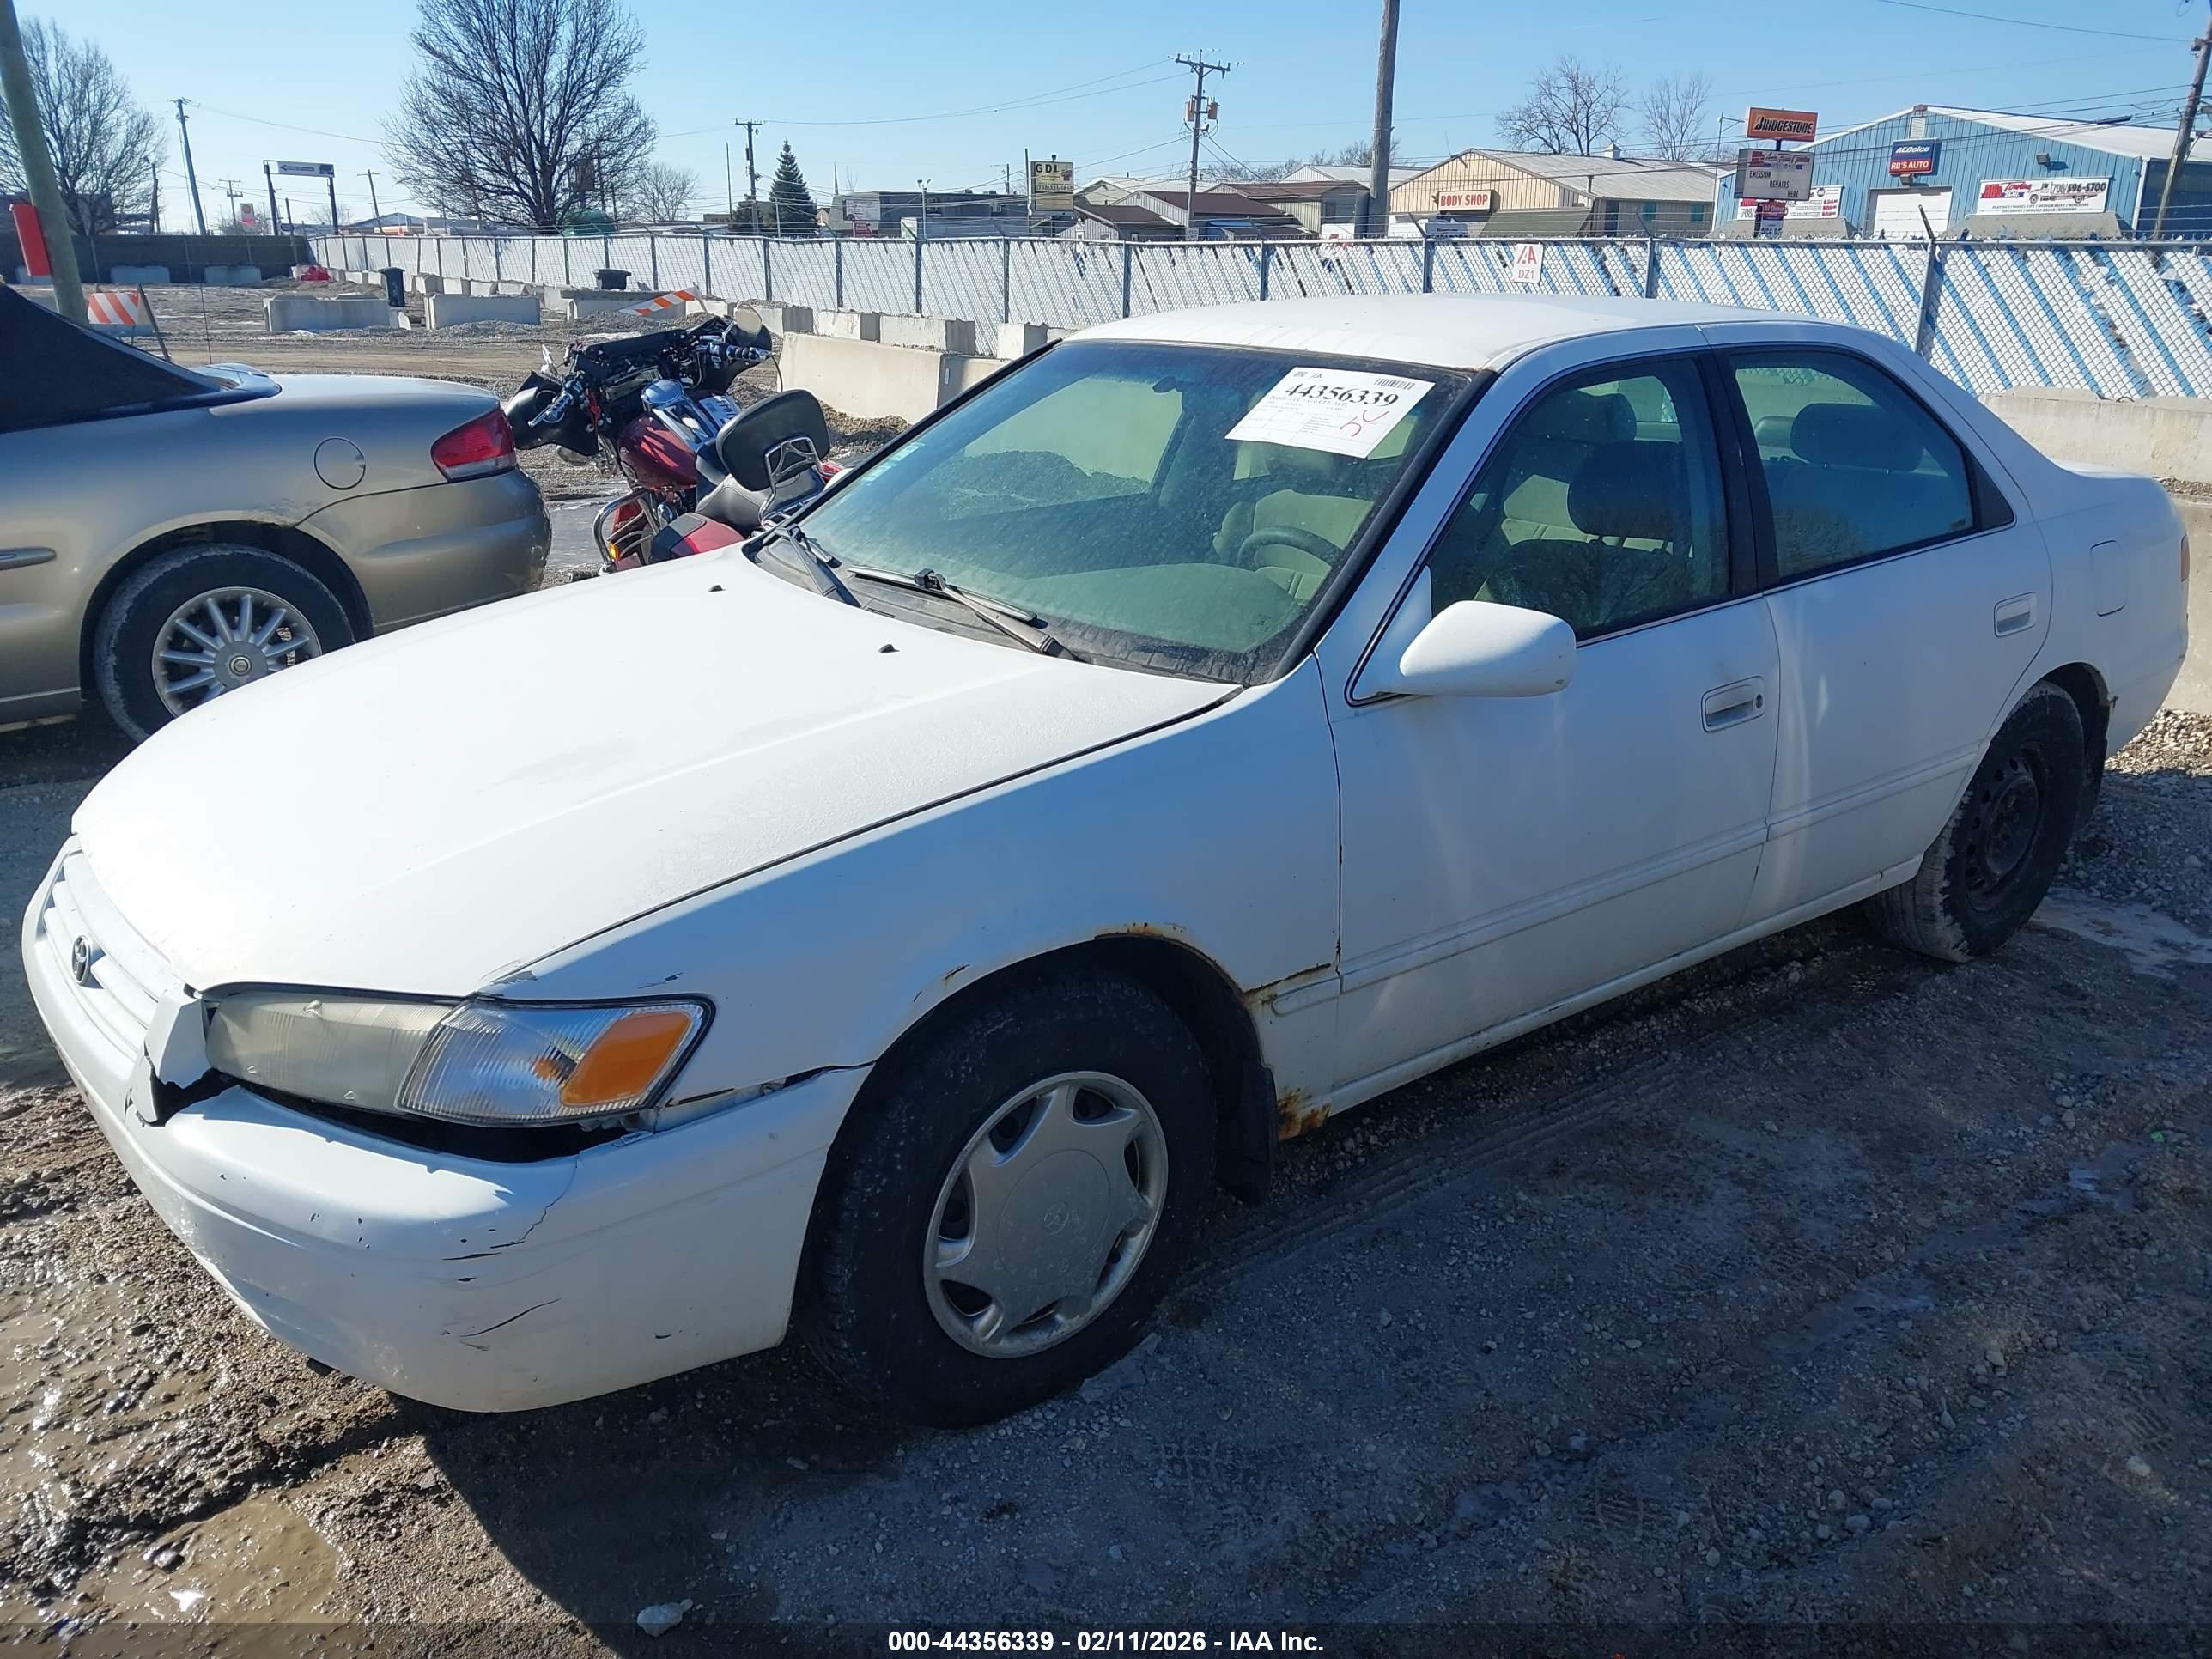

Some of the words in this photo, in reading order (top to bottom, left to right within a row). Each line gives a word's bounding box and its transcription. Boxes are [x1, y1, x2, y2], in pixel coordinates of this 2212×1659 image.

[1754, 117, 1813, 134] BRIDGESTONE
[1908, 161, 1929, 169] AUTO
[1440, 195, 1462, 207] BODY
[1464, 194, 1488, 206] SHOP
[1518, 269, 1534, 279] DZ1
[1285, 383, 1398, 405] 44356339
